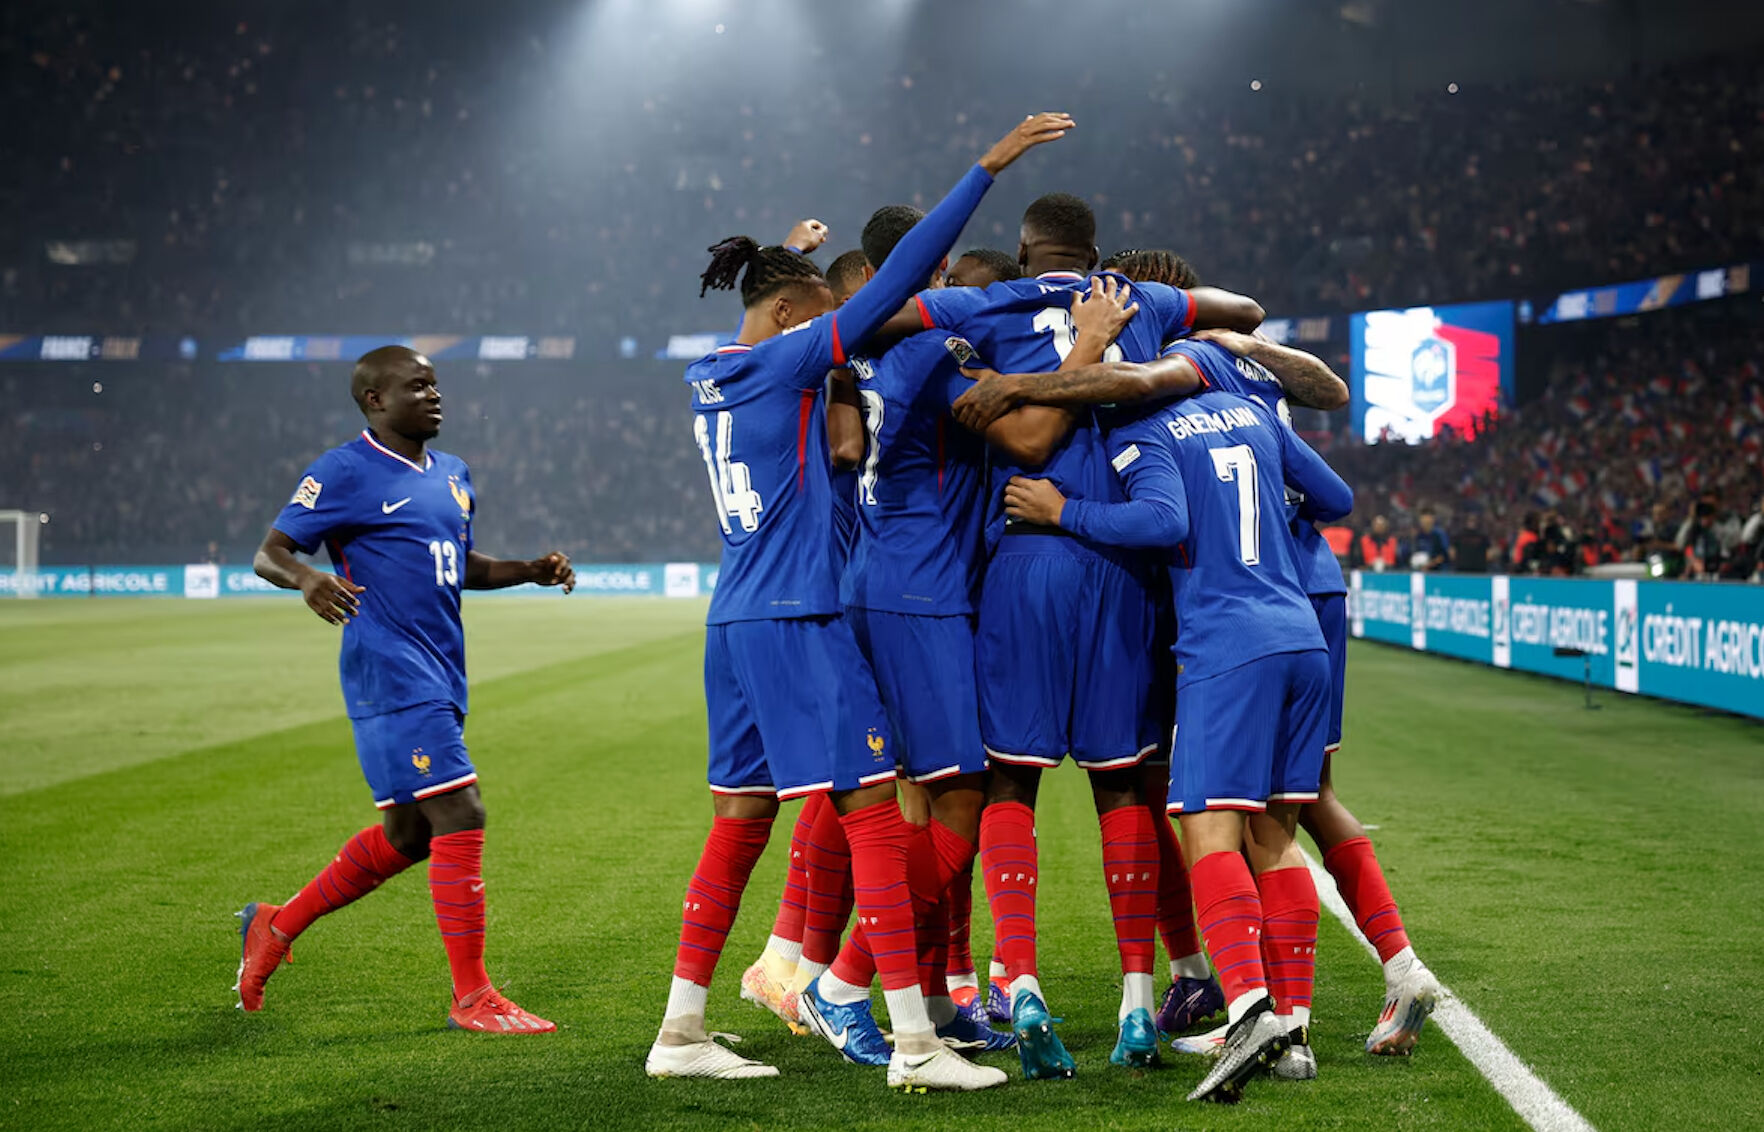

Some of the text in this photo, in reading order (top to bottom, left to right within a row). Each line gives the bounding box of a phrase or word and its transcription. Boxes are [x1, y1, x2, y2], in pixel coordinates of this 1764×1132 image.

[694, 410, 763, 535] 14
[1208, 443, 1260, 566] 7
[61, 573, 167, 591] AGRICOLE
[429, 540, 458, 587] 13
[1643, 602, 1702, 668] CRÉDIT
